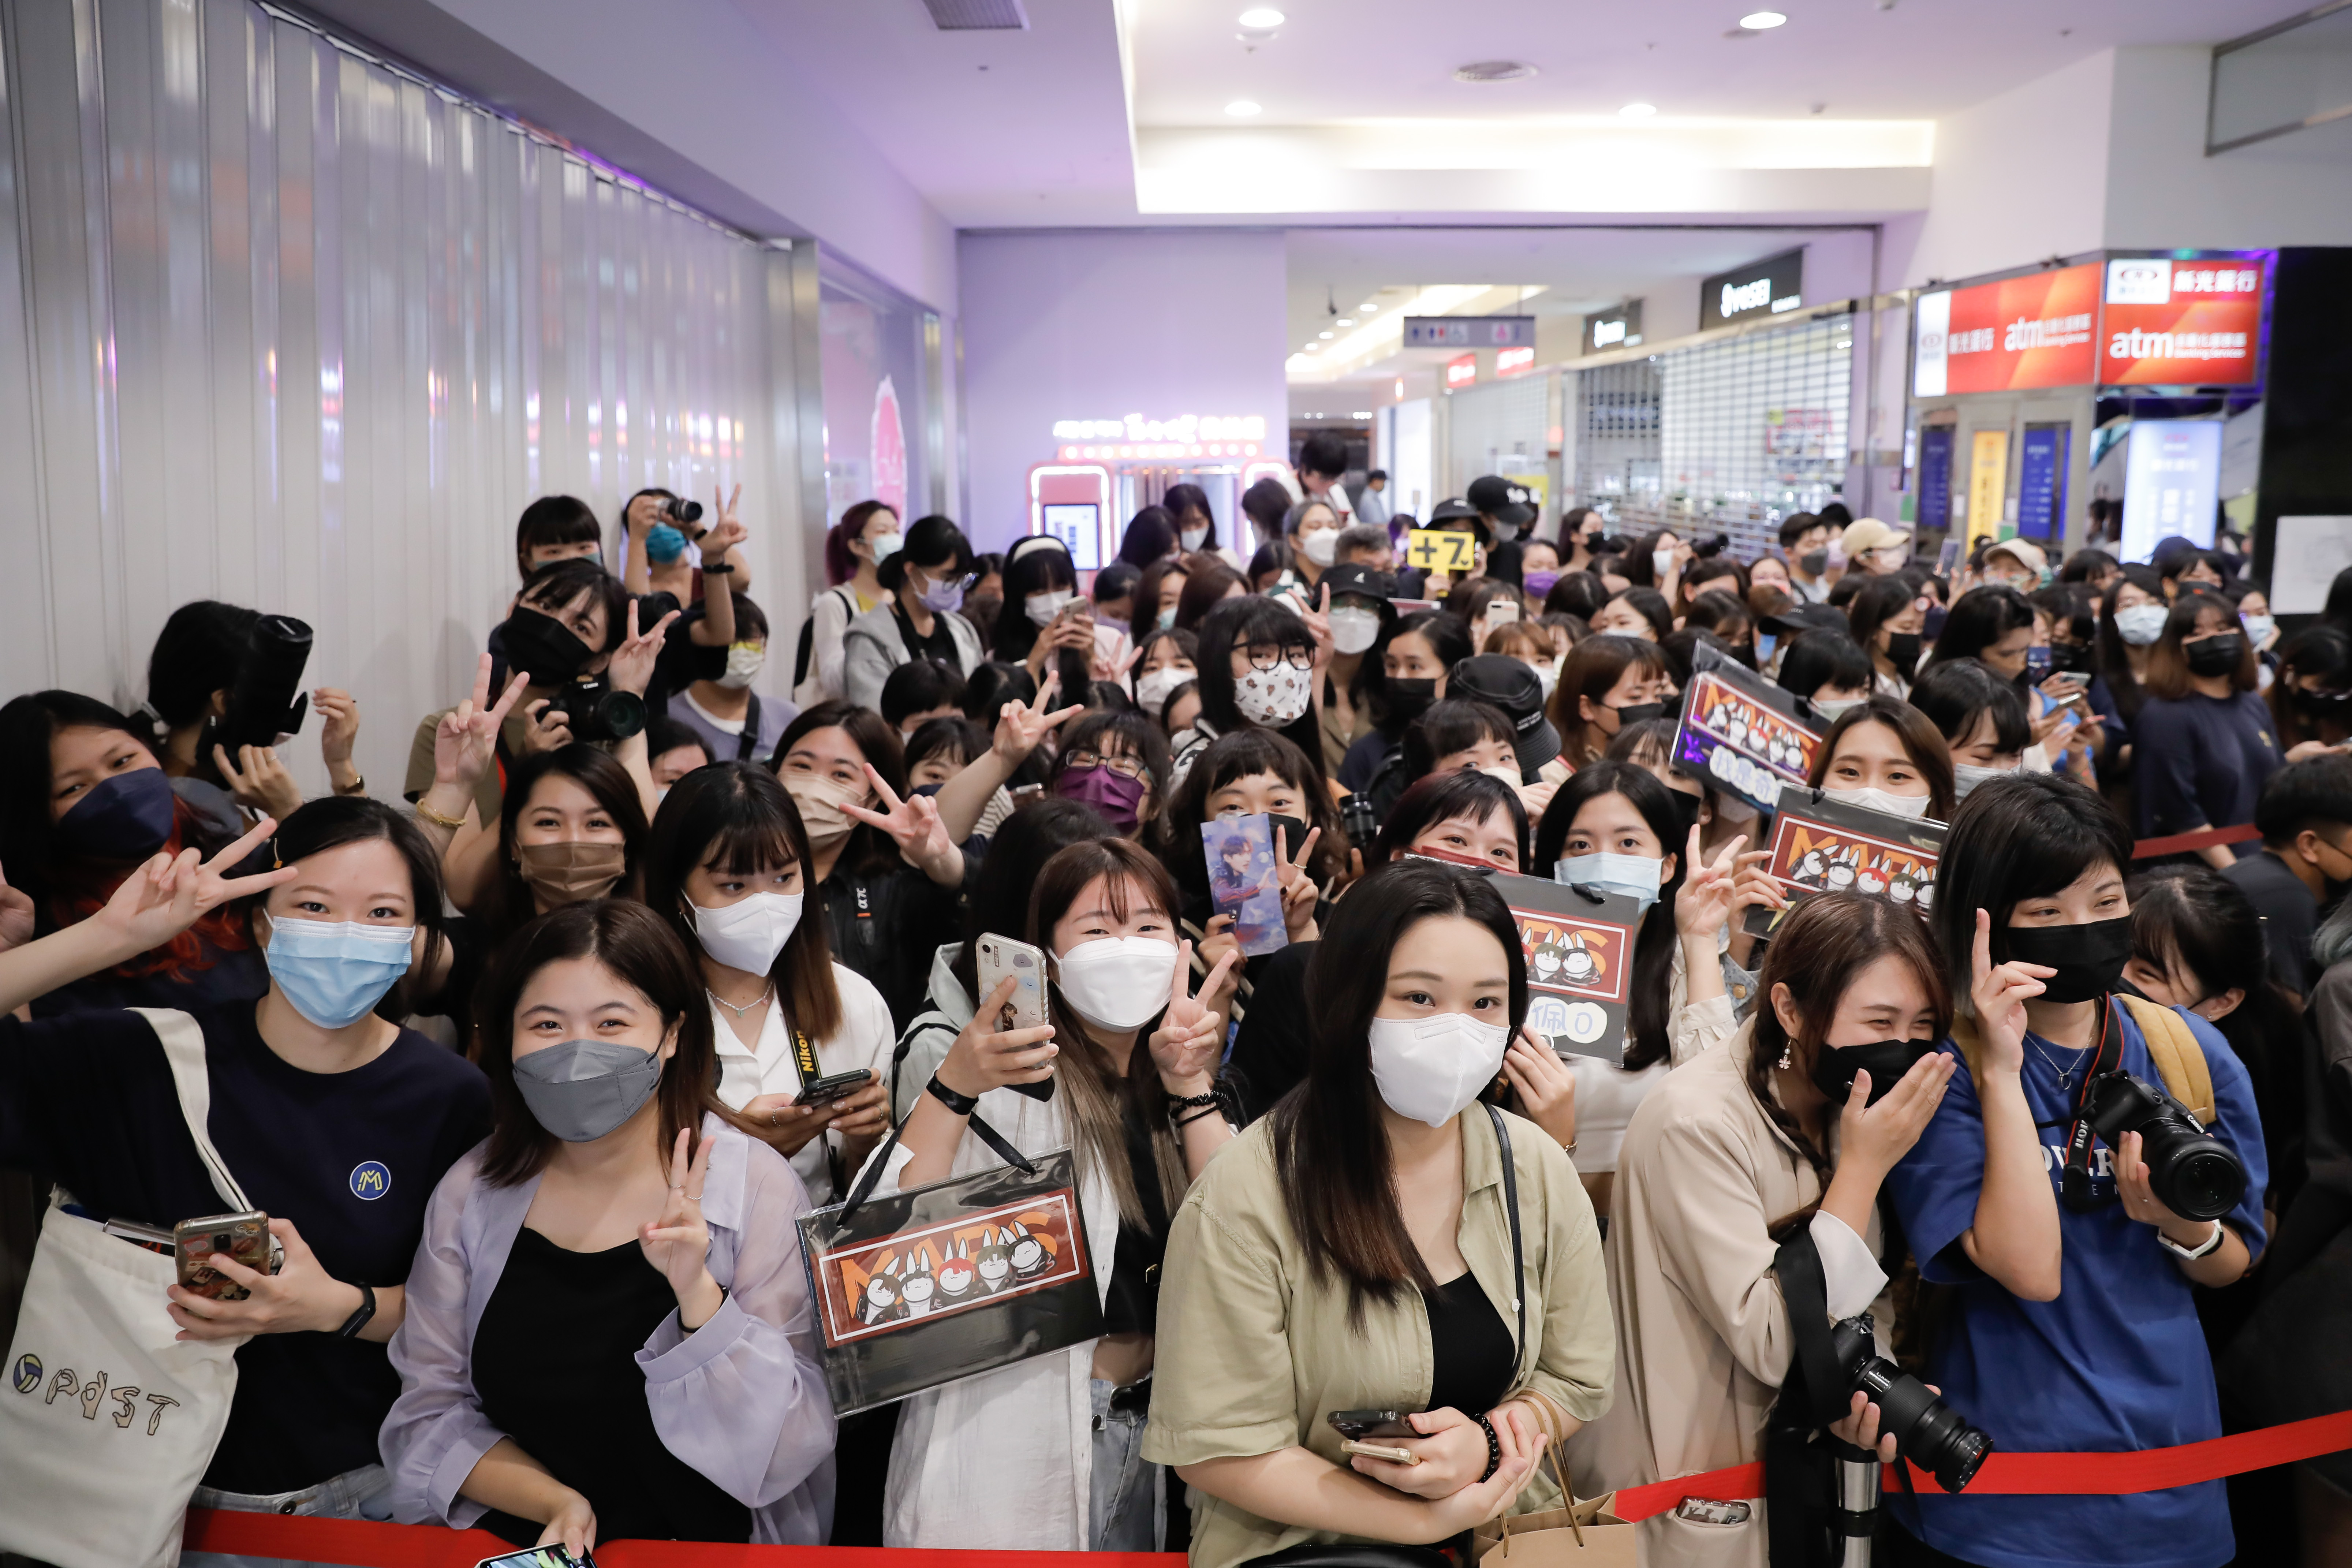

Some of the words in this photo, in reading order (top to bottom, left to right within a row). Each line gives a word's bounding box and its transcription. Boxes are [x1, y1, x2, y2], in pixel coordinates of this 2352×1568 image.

[2005, 316, 2045, 351] atm
[2109, 327, 2174, 359] atm
[1786, 826, 1937, 893] MAR
[796, 1030, 814, 1072] Nikon
[2187, 1115, 2204, 1134] Canon
